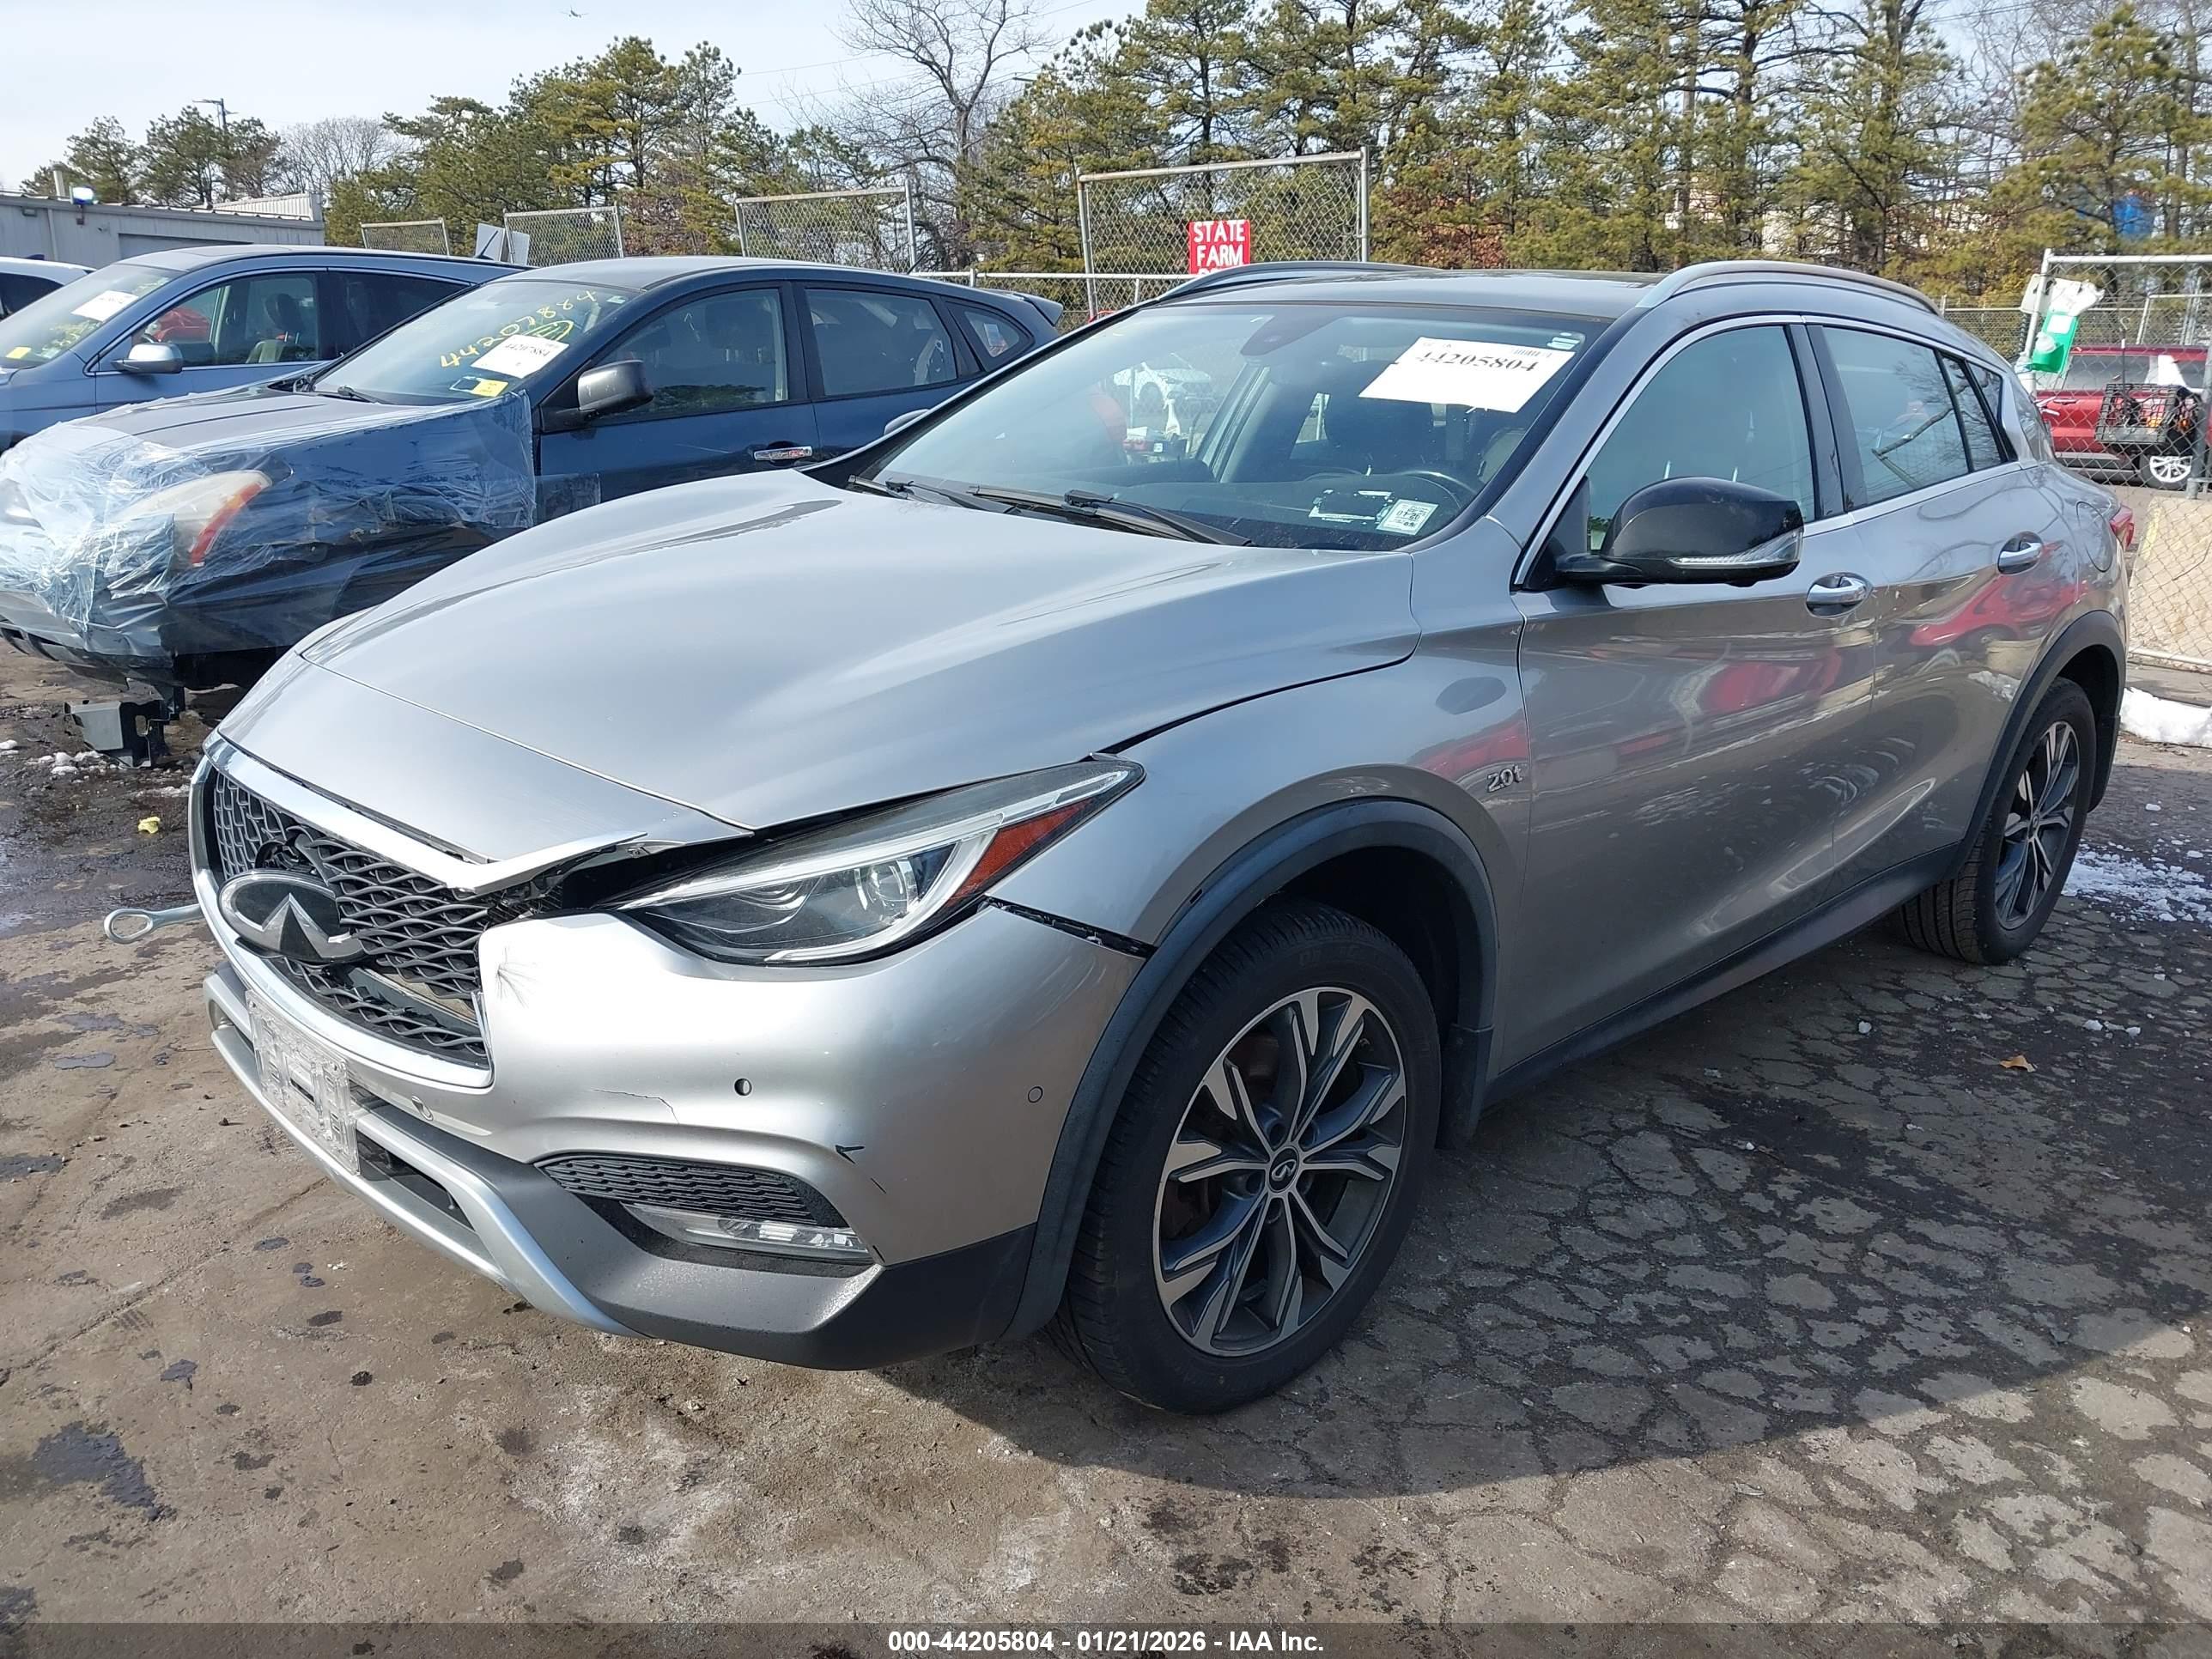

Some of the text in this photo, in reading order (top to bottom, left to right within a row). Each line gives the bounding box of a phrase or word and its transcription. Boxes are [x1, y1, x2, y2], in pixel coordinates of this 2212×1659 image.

[1193, 219, 1246, 243] STATE
[1196, 244, 1243, 267] FARM
[1414, 350, 1540, 373] 44205804
